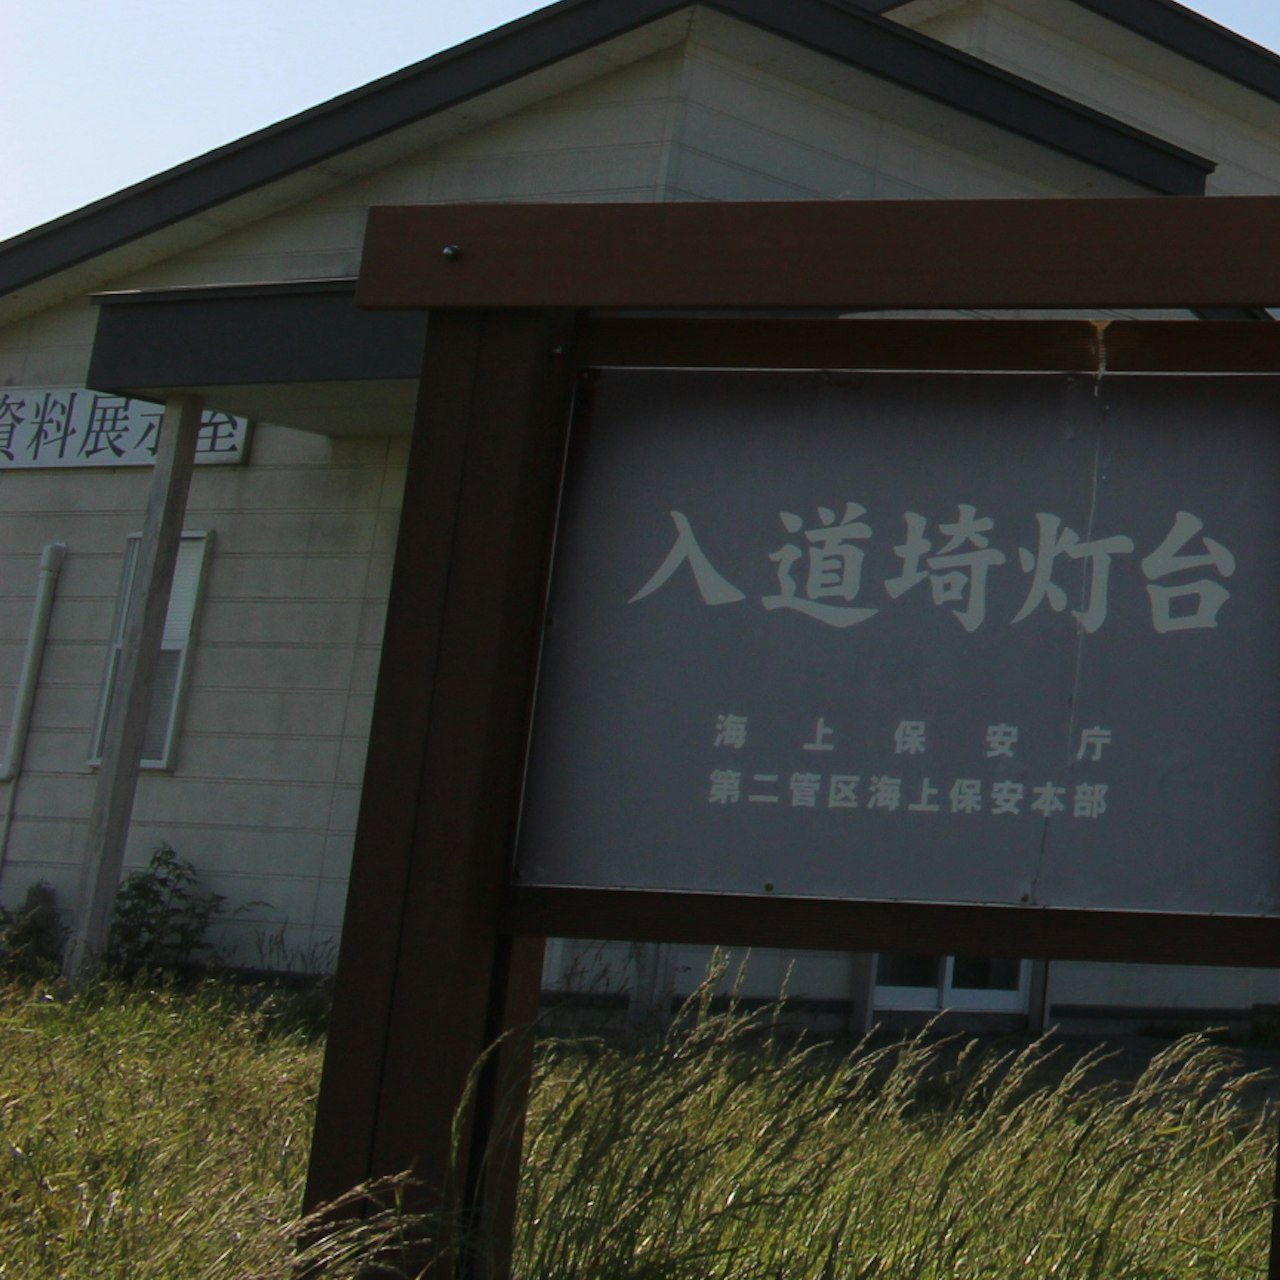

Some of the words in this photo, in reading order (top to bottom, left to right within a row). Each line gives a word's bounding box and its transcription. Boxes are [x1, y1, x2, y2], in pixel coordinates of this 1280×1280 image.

[628, 501, 1236, 634] 入道埼灯台
[713, 713, 1112, 761] 海上保安庁
[708, 768, 1109, 819] 第二管区海上保安本部
